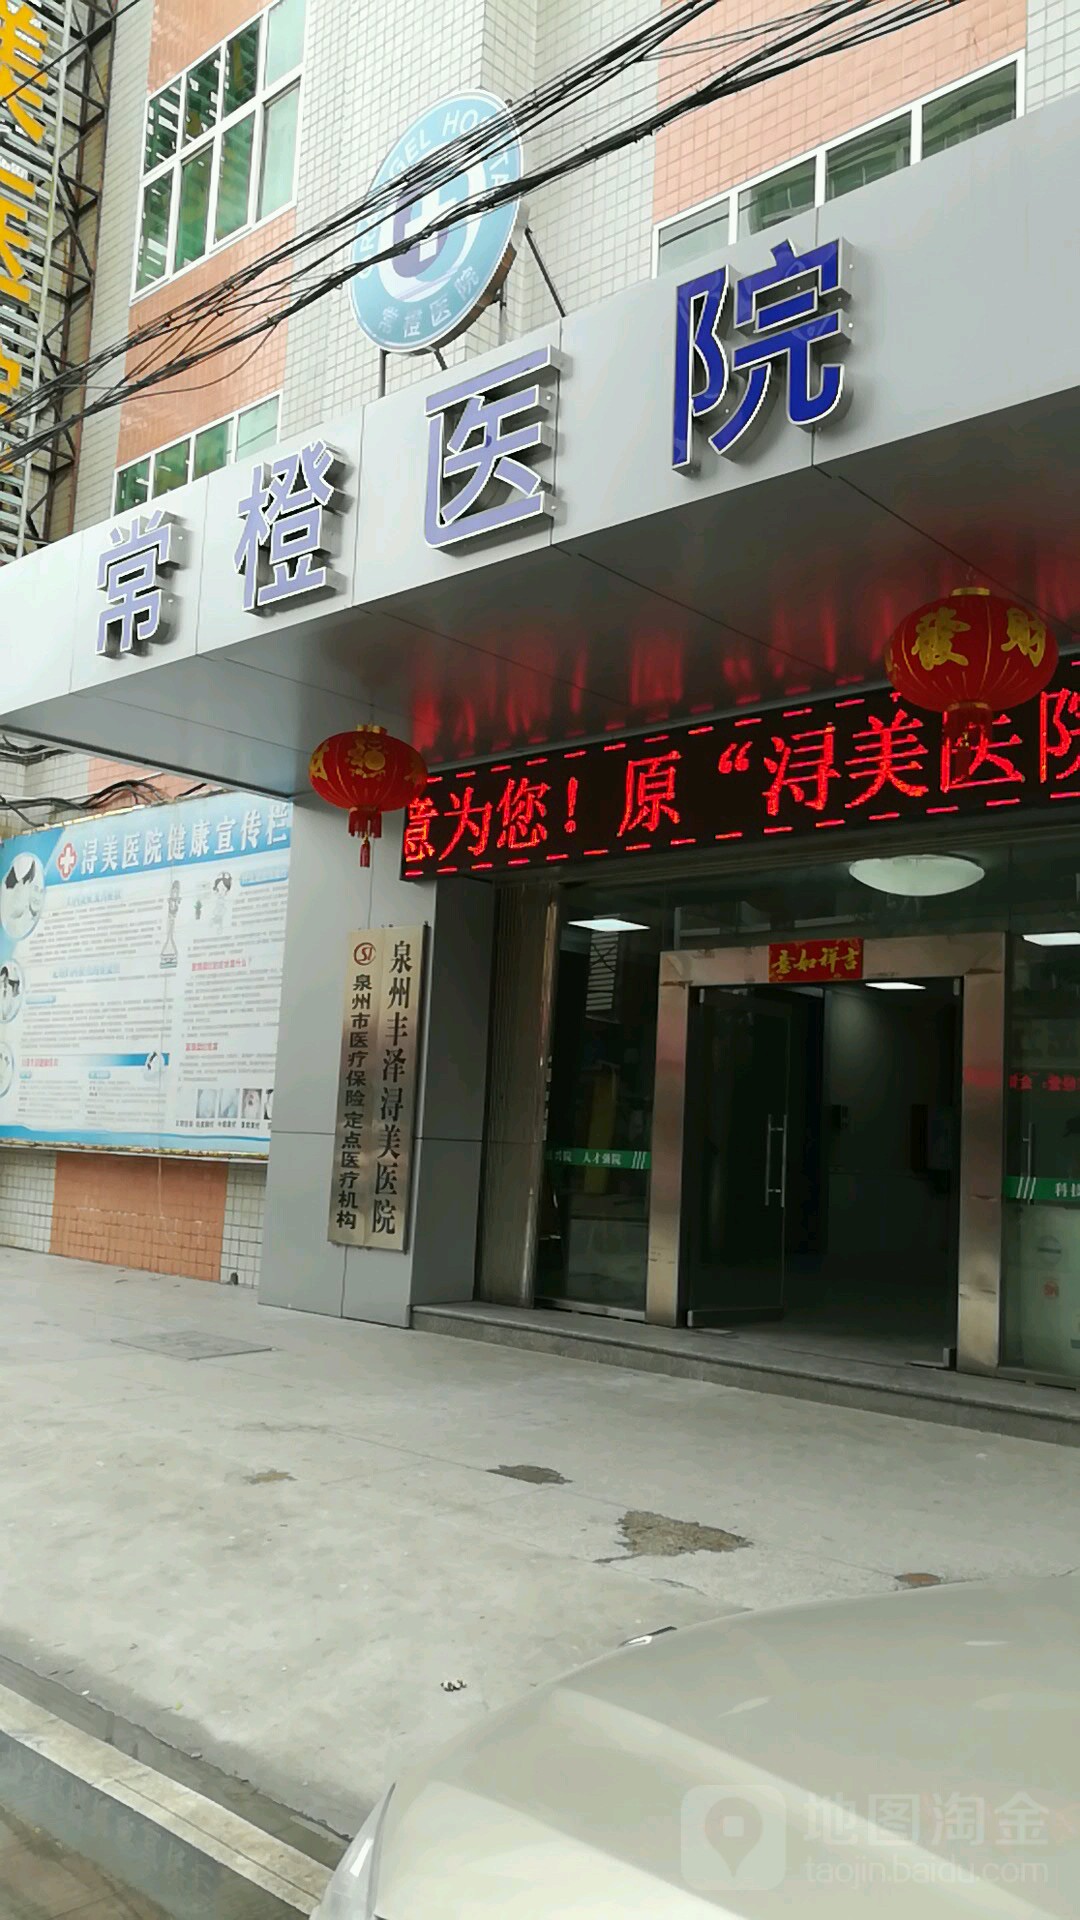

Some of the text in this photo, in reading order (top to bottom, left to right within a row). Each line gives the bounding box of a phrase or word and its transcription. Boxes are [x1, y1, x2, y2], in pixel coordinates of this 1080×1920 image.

[96, 238, 848, 656] 常橙医院
[81, 803, 288, 875] 浔美医院健康宣传栏
[336, 974, 372, 1230] 泉州市医疗保险定点医疗机构
[371, 940, 413, 1235] 泉州丰泽浔美医院
